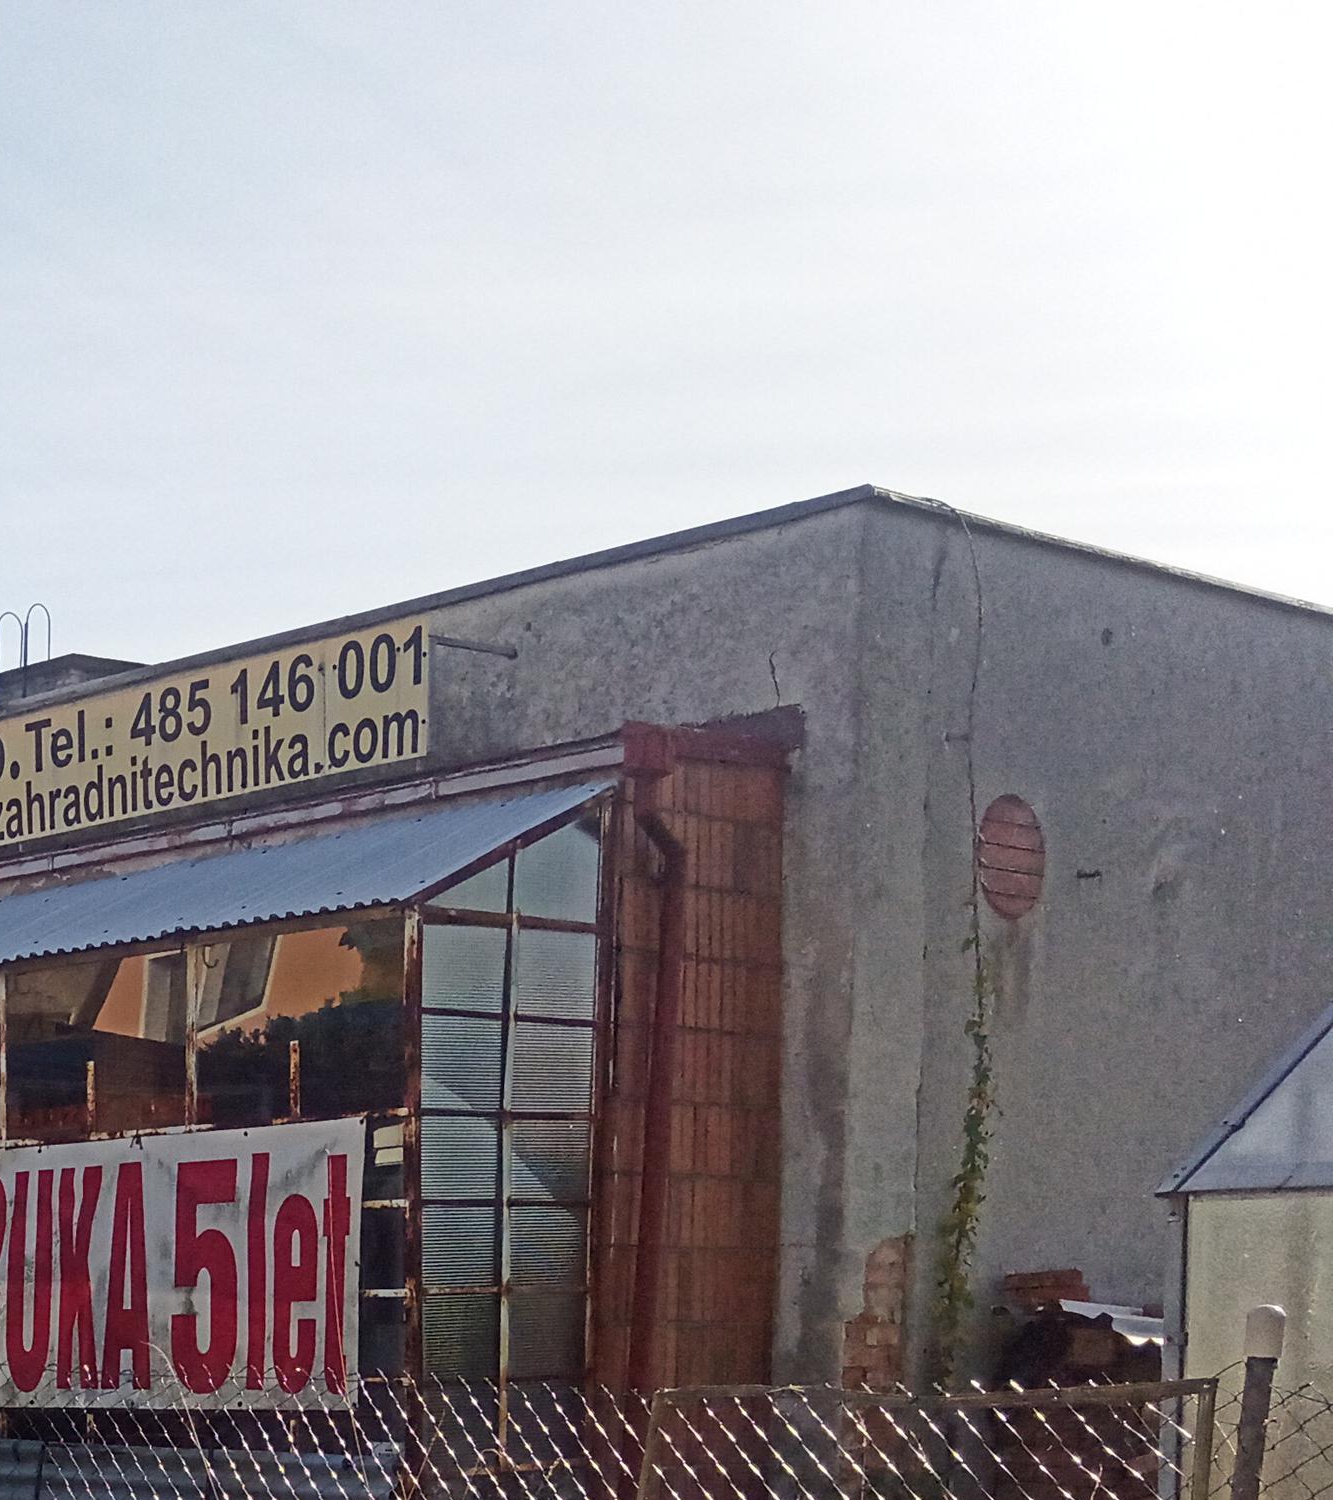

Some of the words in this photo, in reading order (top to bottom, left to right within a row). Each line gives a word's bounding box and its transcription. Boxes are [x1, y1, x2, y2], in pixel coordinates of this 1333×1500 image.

[25, 709, 114, 773] Tel.:
[130, 678, 212, 747] 485
[230, 653, 315, 726] 146
[337, 624, 423, 700] 001
[170, 1158, 239, 1395] 5
[246, 1152, 351, 1395] let
